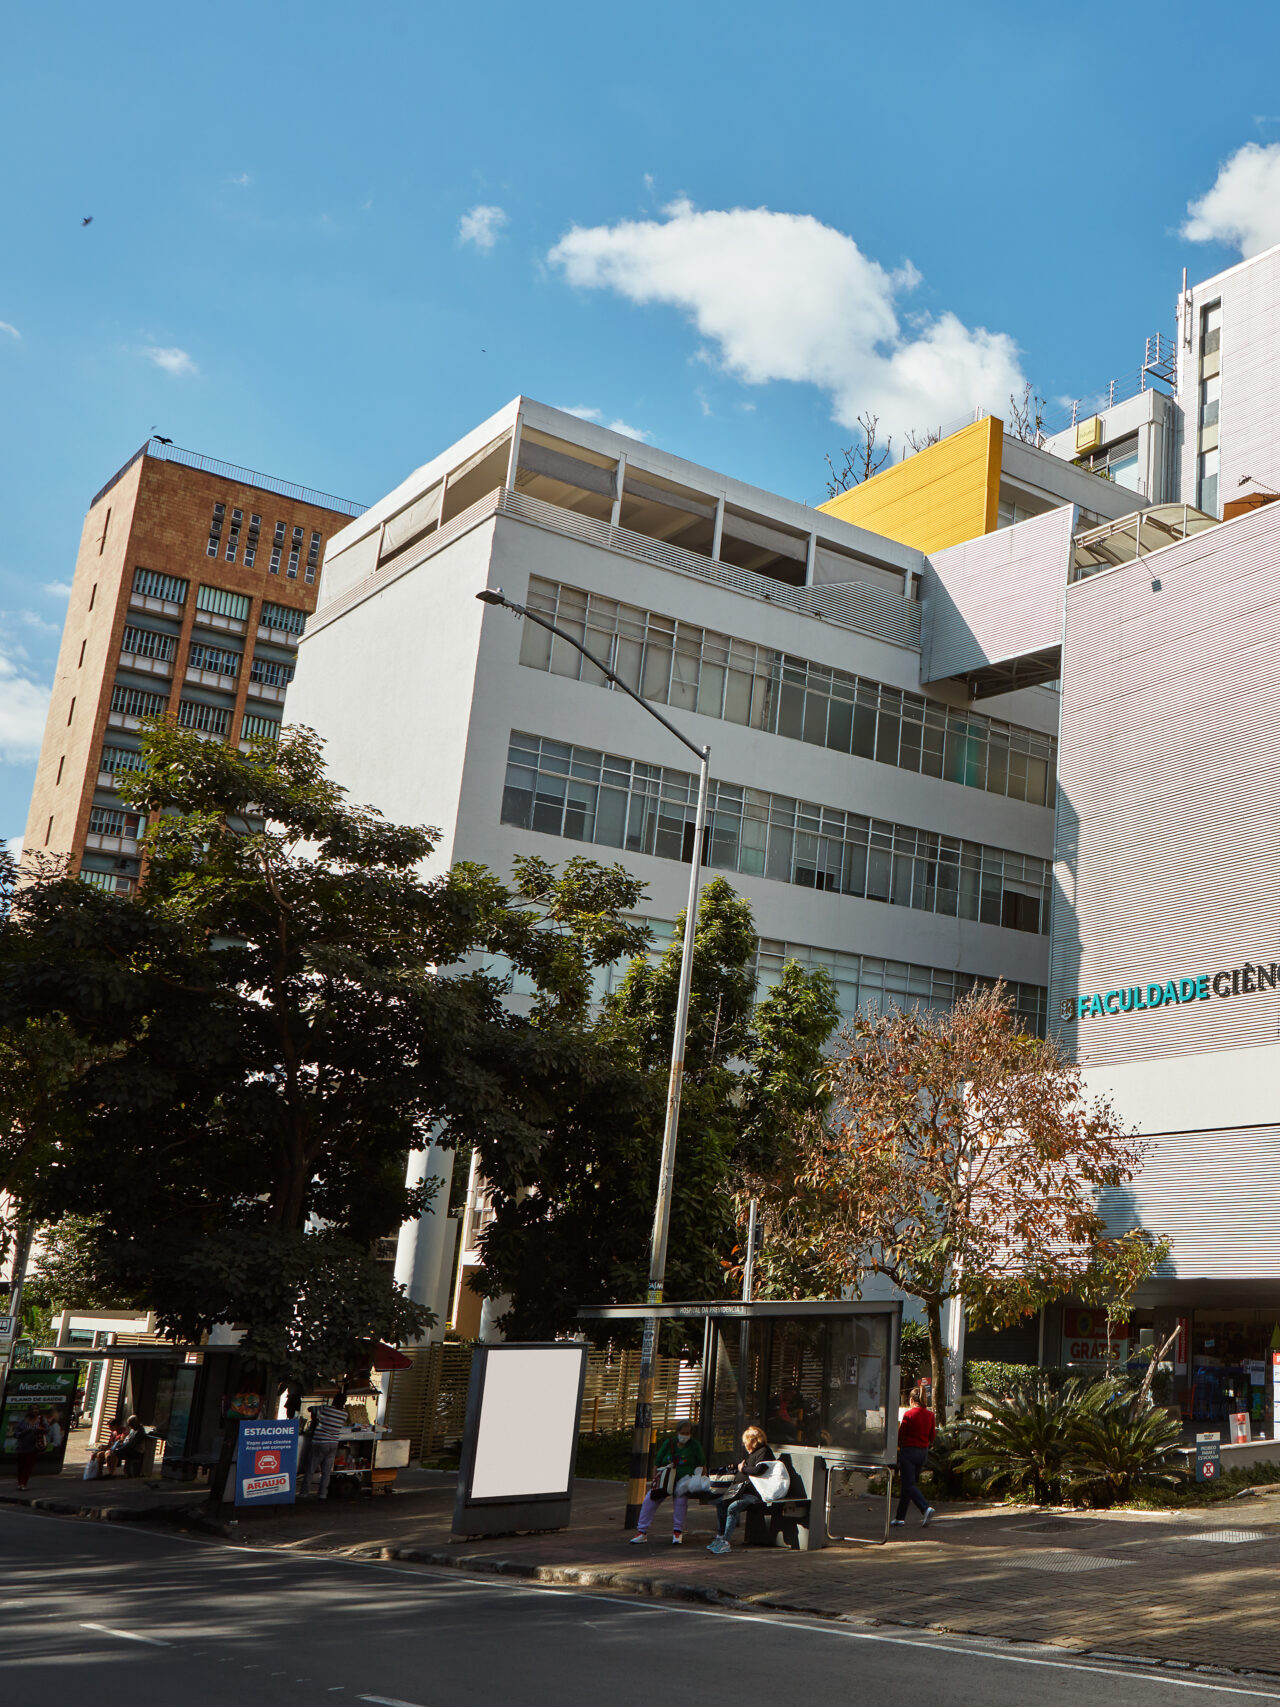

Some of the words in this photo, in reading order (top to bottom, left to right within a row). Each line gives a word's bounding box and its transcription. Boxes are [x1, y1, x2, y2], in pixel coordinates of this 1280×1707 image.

[1078, 975, 1209, 1018] FACULDADE
[679, 1306, 701, 1314] HOSPITAL
[244, 1427, 295, 1436] ESTACIONE
[247, 1478, 286, 1490] ARAUJO
